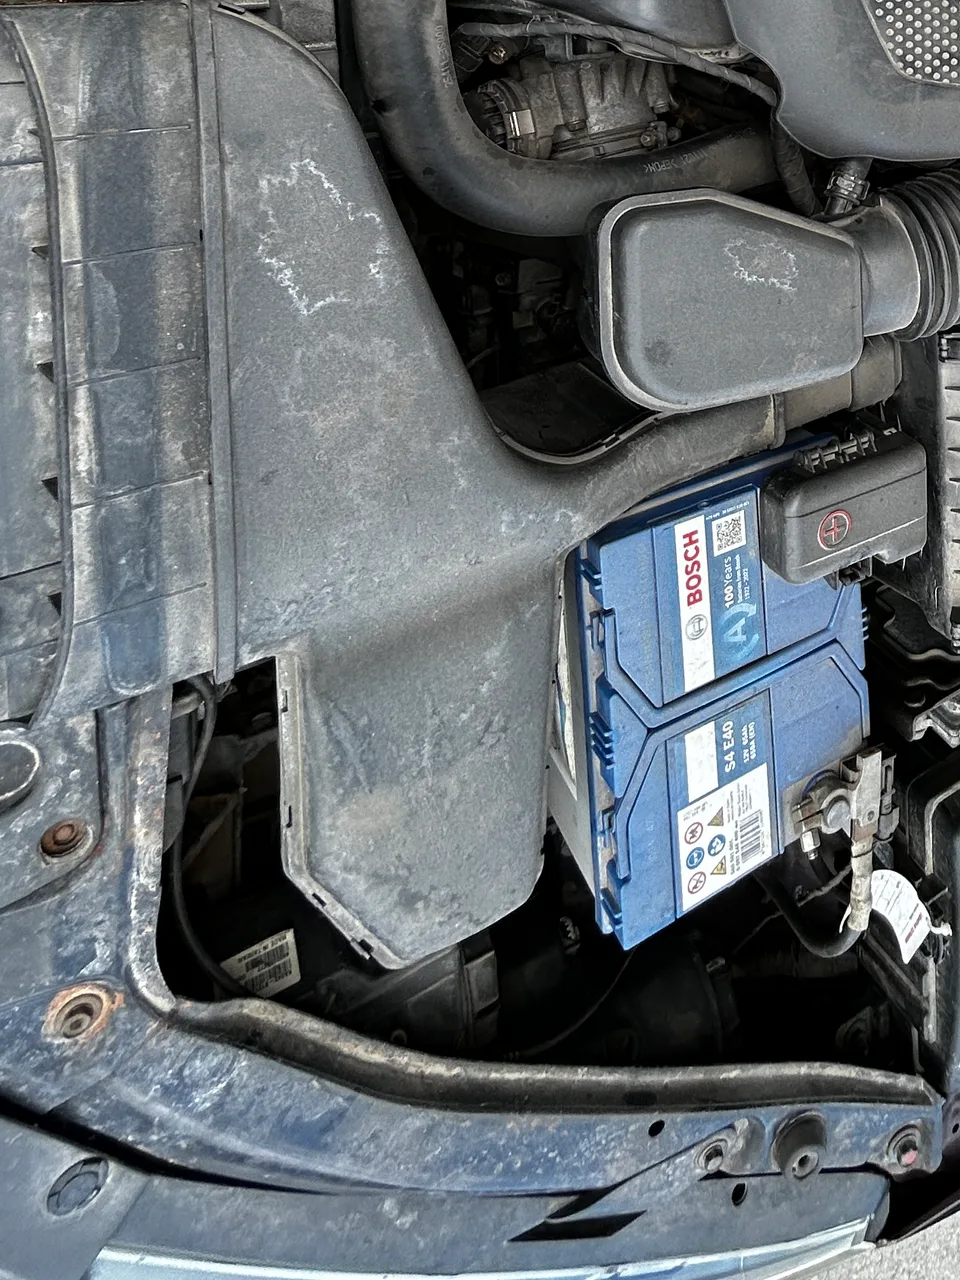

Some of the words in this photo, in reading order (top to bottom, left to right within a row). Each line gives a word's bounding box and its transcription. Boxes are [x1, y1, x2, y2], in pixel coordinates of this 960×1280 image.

[683, 529, 703, 607] BOSCH
[722, 721, 735, 751] E40
[725, 751, 735, 773] S4
